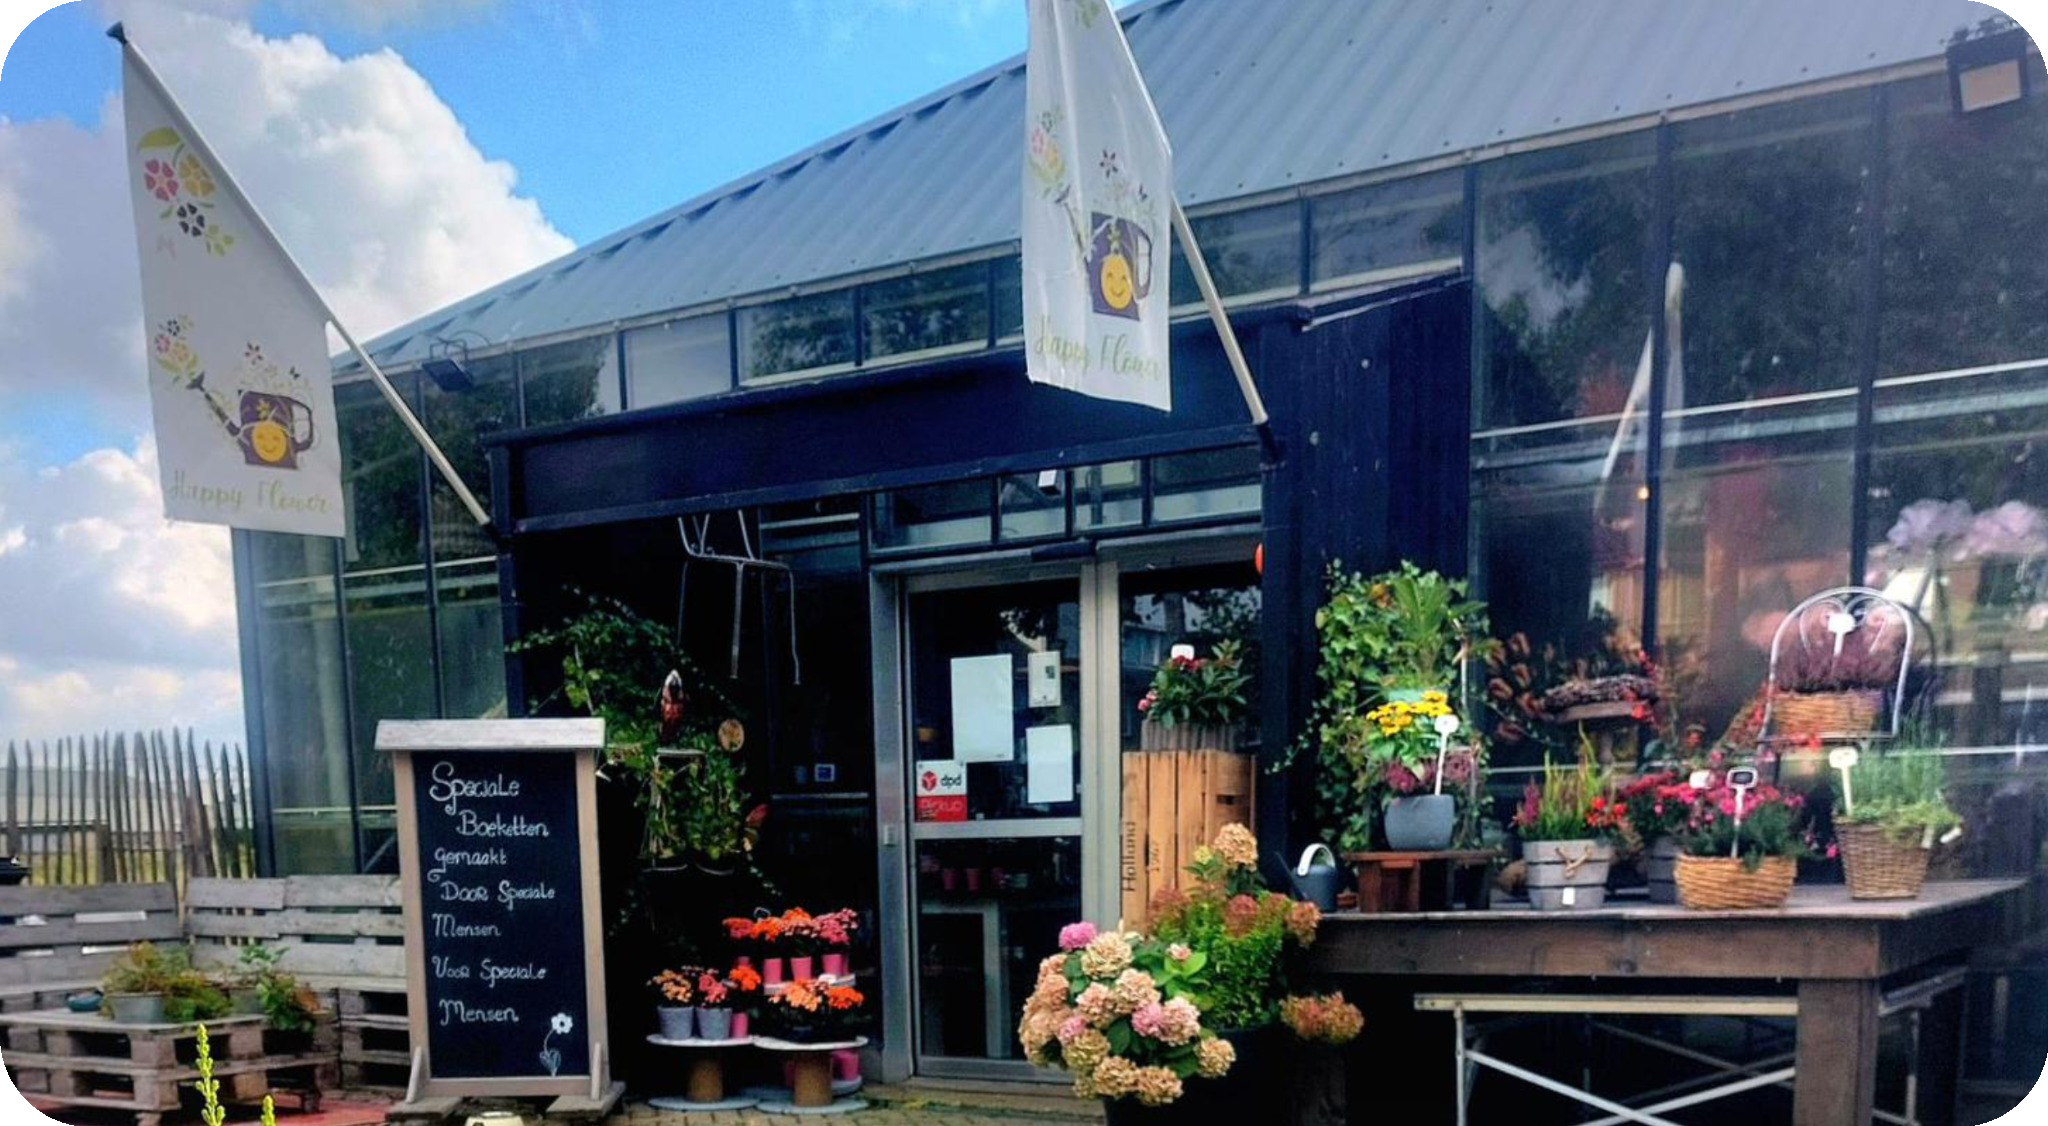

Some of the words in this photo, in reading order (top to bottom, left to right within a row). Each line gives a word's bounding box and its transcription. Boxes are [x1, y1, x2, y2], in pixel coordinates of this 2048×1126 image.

[170, 470, 243, 511] Happy
[257, 479, 330, 514] Flower
[940, 773, 962, 790] dpd
[455, 809, 550, 838] Boeketten
[1121, 821, 1136, 892] Holland
[432, 913, 502, 937] Mensen
[439, 999, 519, 1027] Mensen
